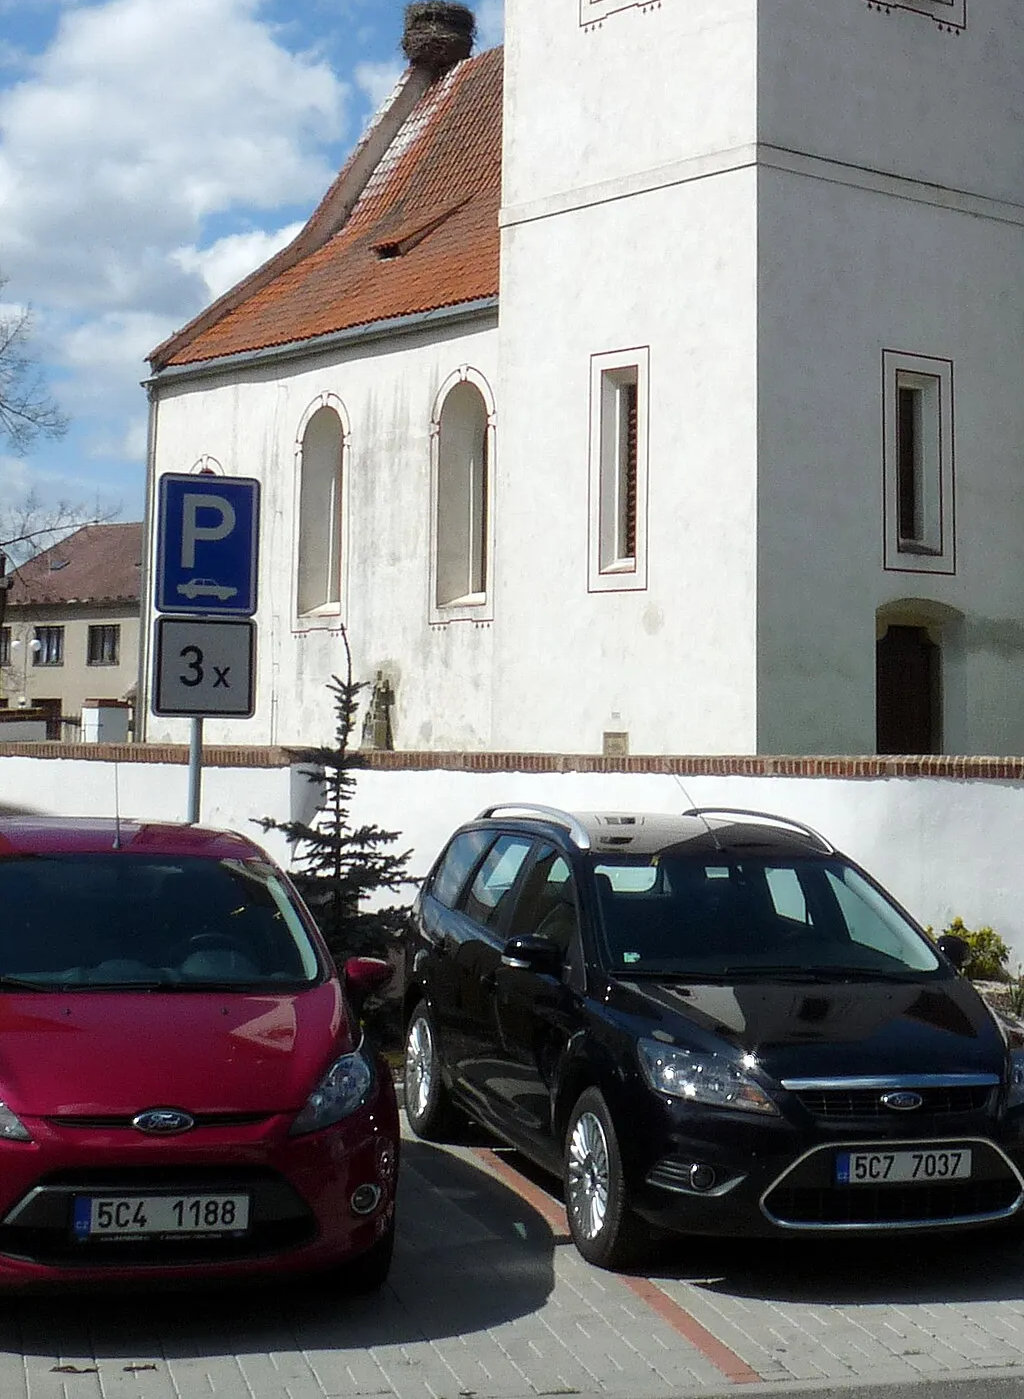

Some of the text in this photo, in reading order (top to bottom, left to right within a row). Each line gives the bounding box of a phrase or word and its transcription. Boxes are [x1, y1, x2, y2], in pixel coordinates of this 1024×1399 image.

[180, 493, 236, 569] P
[855, 1153, 962, 1179] 5C7 7037
[98, 1200, 235, 1228] 5C4 1188
